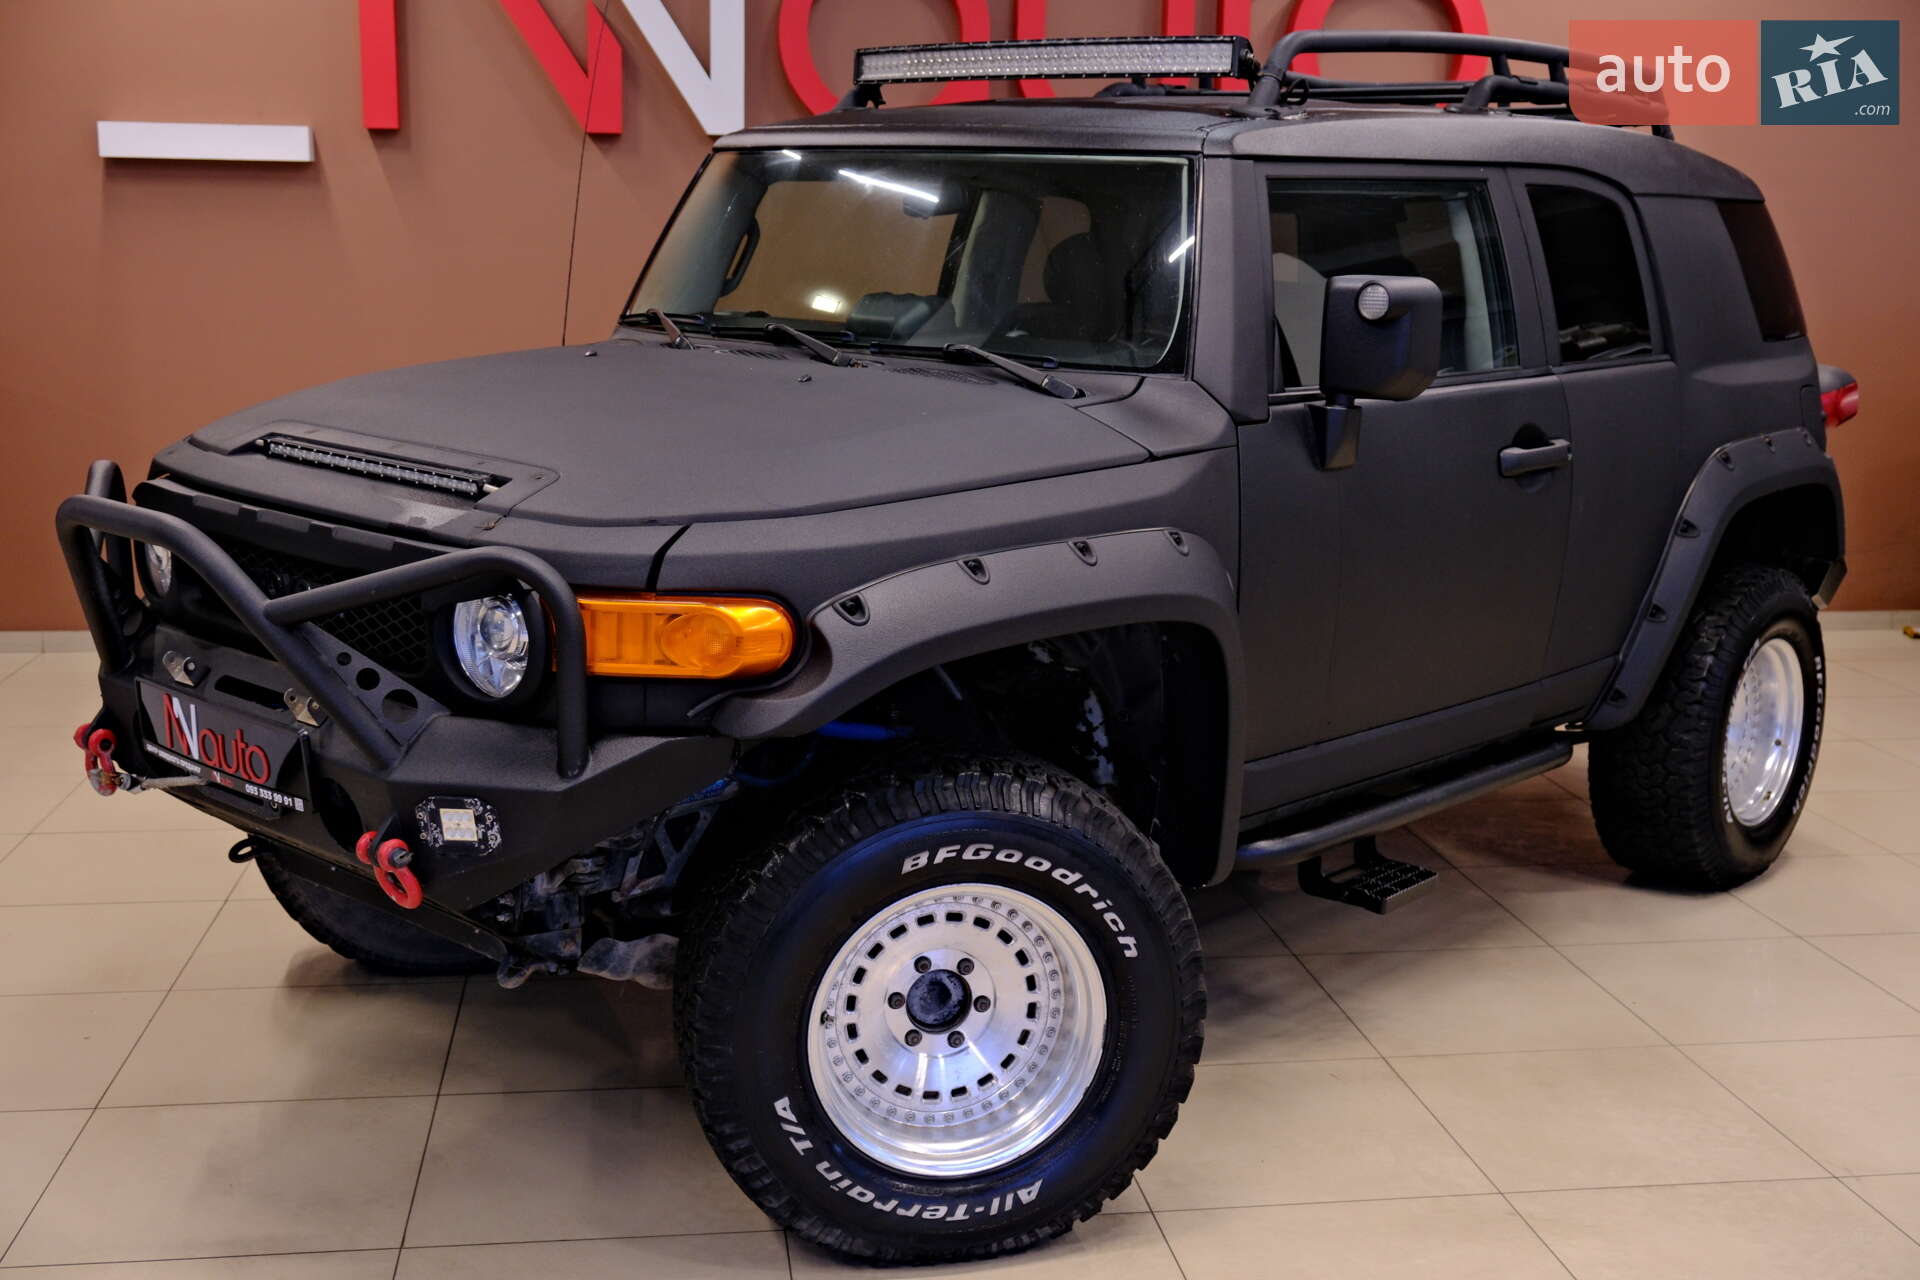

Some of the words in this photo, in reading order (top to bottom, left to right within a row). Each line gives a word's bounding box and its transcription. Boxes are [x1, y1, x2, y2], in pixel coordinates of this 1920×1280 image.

[901, 843, 1139, 958] BFGoodrich
[773, 1096, 814, 1156] T/A
[815, 1160, 1044, 1222] All-Terrain
